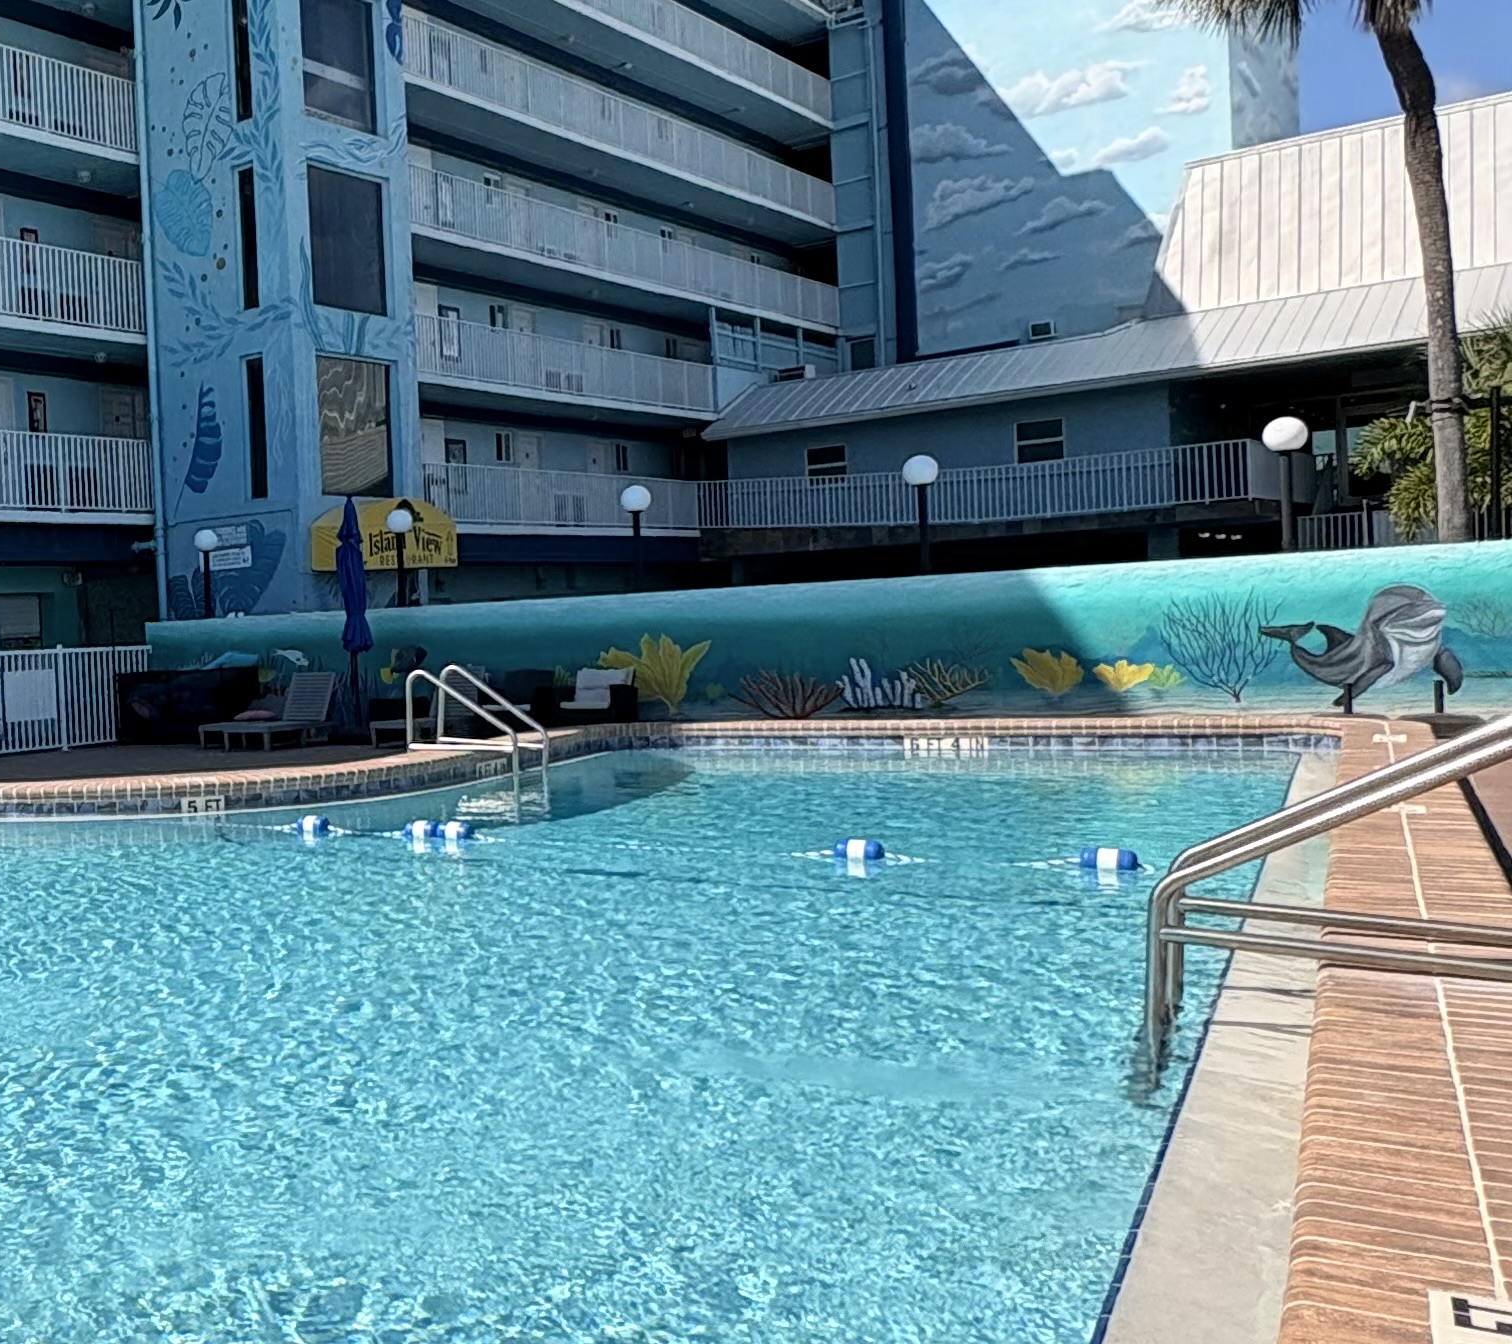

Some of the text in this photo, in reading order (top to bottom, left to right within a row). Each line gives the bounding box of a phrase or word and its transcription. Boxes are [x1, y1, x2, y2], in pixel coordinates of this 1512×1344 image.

[379, 554, 434, 567] RESURANT
[951, 736, 961, 750] 4
[187, 798, 222, 813] 5 FT
